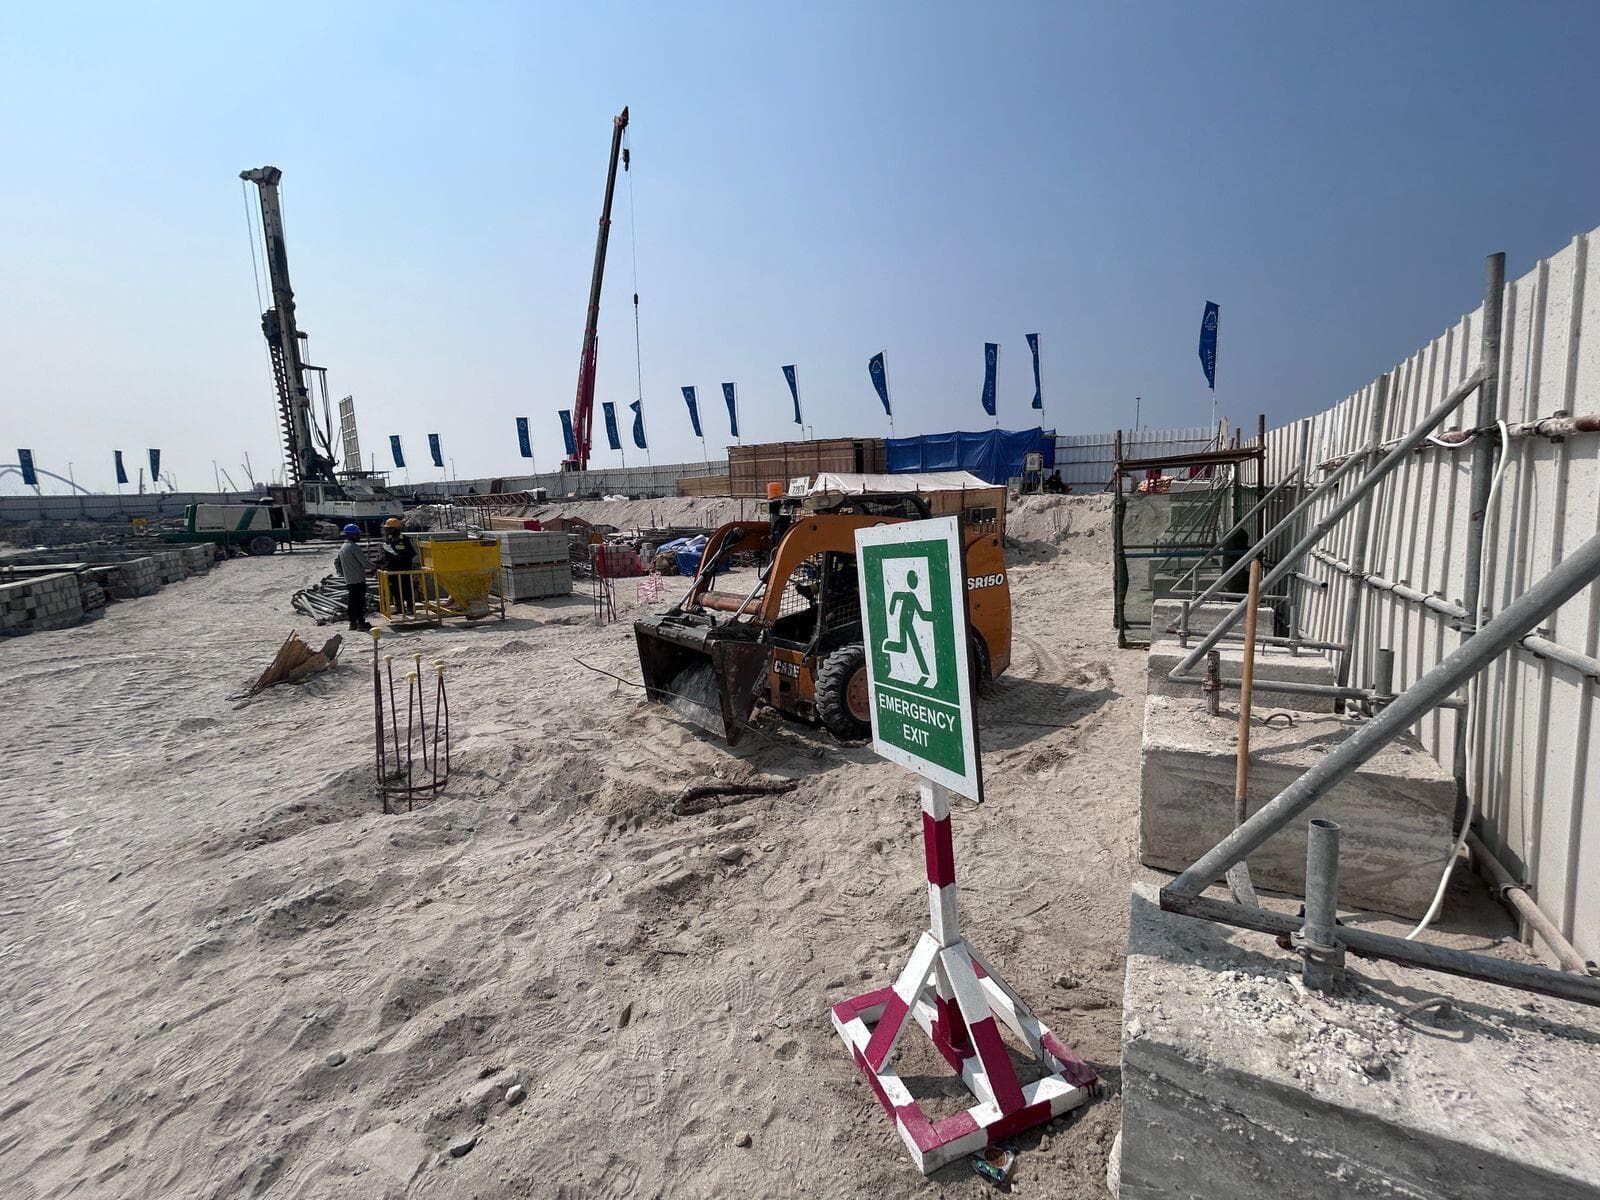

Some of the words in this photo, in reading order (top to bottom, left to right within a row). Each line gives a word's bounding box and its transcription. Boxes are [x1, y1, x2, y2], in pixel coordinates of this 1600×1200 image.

[967, 573, 1004, 590] SR150
[774, 660, 800, 678] CASE
[878, 693, 956, 732] EMERGENCY
[902, 723, 930, 747] EXIT
